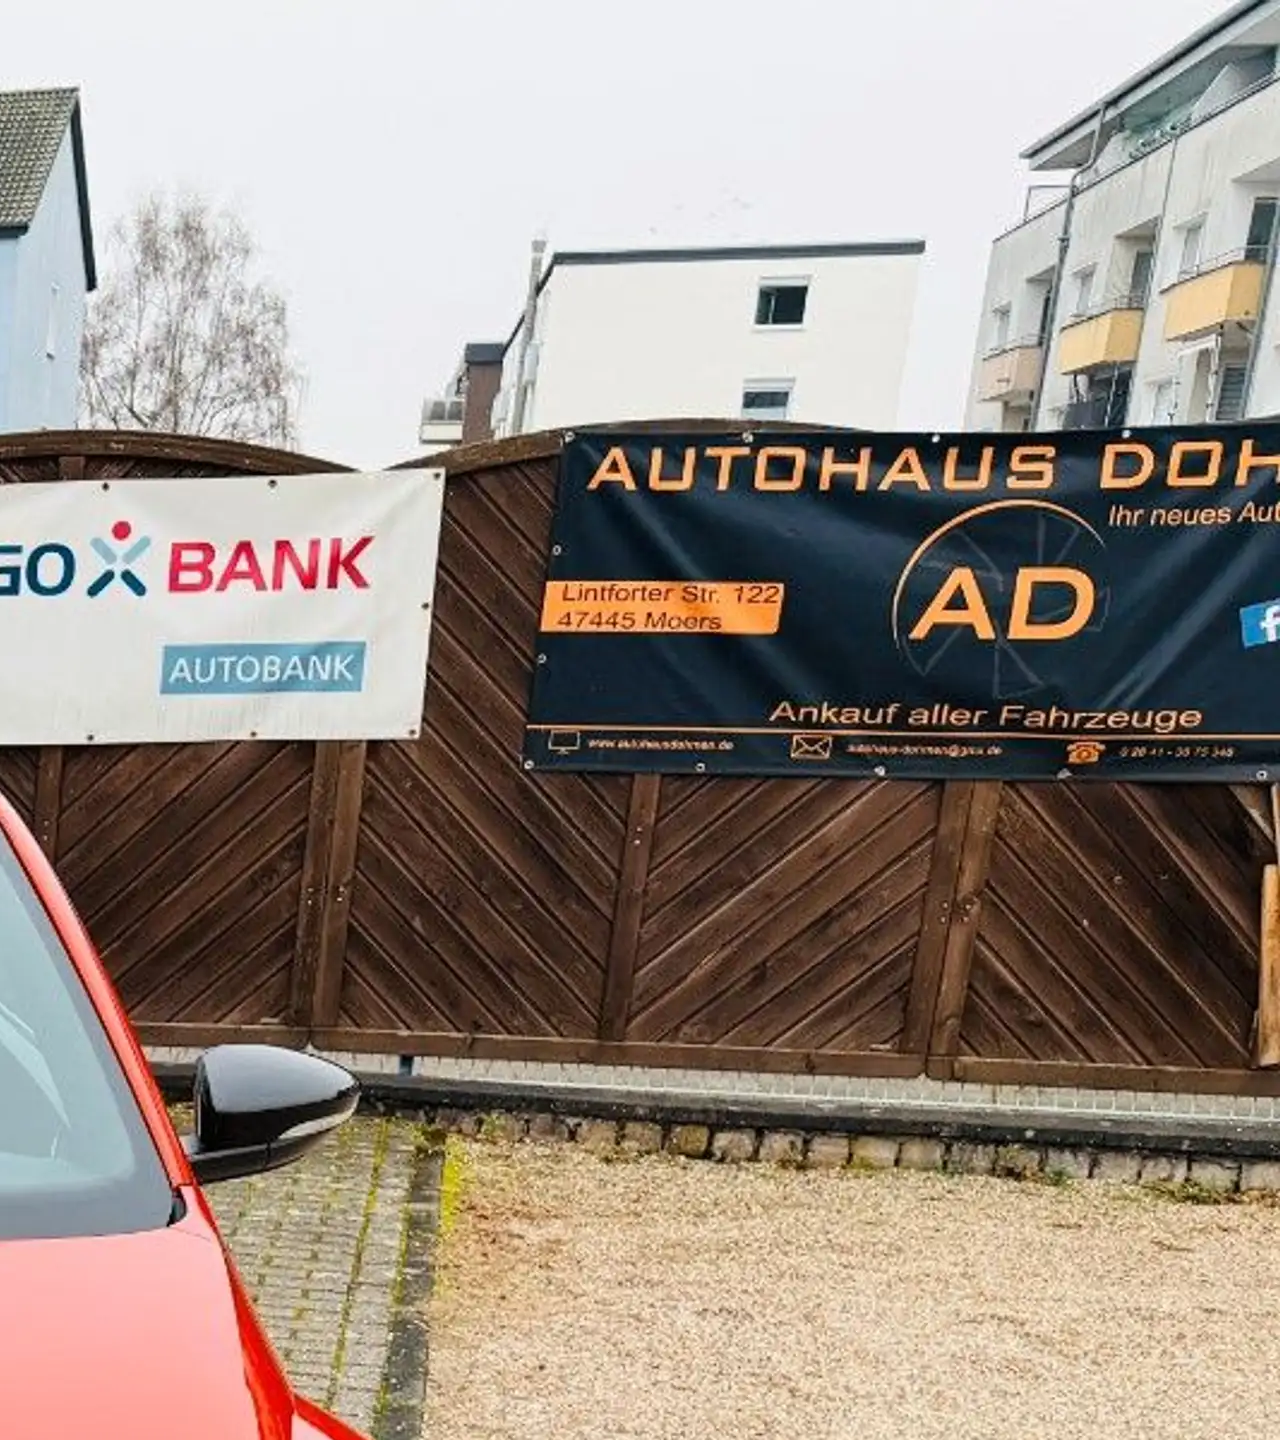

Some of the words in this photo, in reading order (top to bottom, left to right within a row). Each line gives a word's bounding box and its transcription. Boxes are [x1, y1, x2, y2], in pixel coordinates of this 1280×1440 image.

[587, 445, 1055, 493] AUTOHAUS
[1108, 504, 1145, 527] Ihr
[1149, 505, 1232, 527] neues
[167, 535, 375, 594] BANK
[561, 583, 678, 603] Lintforter
[682, 585, 721, 604] Str.
[735, 585, 781, 604] 122
[908, 564, 1096, 641] AD
[557, 611, 636, 629] 47445
[644, 611, 723, 630] Moers
[168, 650, 357, 684] AUTOBANK
[769, 700, 901, 725] Ankauf
[908, 703, 989, 726] aller
[999, 704, 1203, 733] Fahrzeuge
